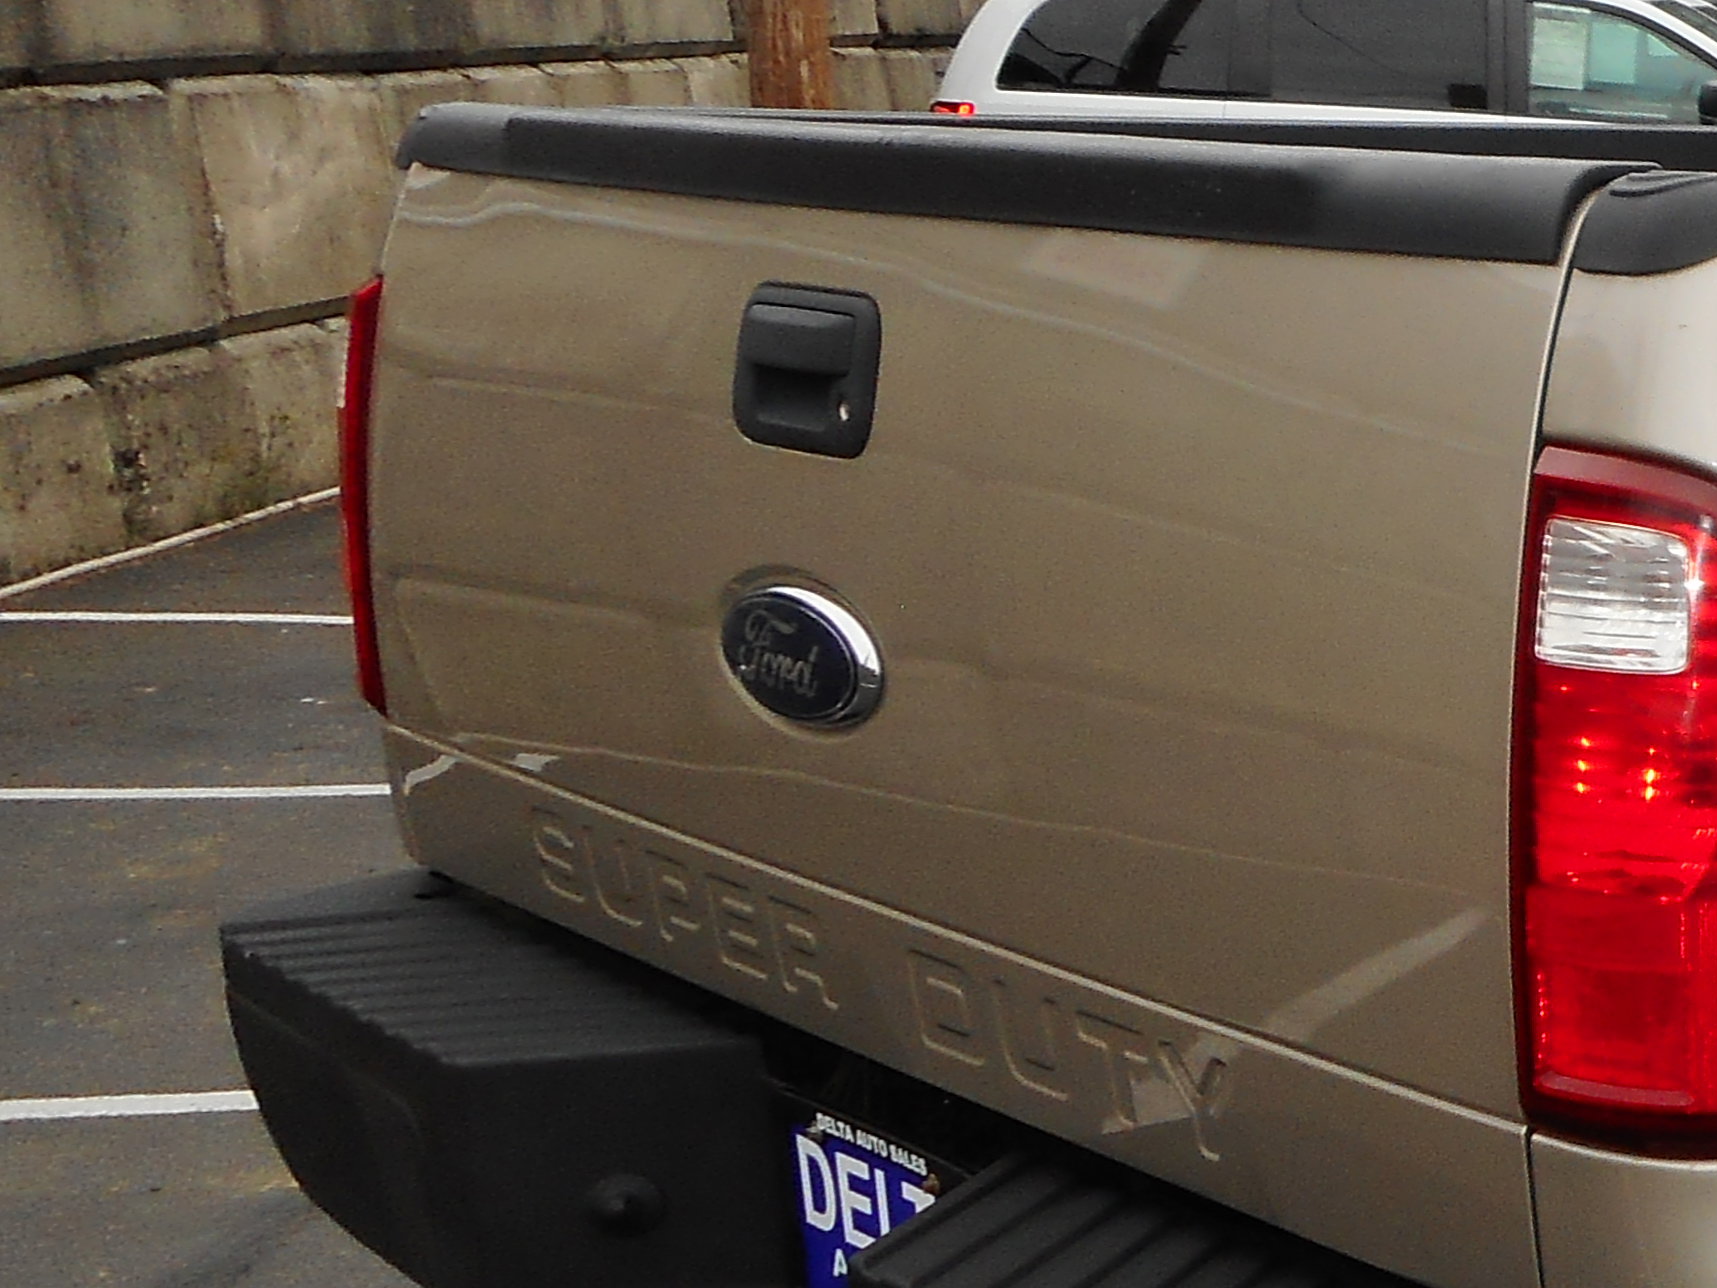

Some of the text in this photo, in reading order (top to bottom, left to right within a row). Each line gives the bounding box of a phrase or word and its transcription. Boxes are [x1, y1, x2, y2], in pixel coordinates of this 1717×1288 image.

[738, 608, 821, 698] Ford
[532, 807, 1228, 1163] SUPER DUTY
[815, 1112, 928, 1176] DELTA AUTO SALES
